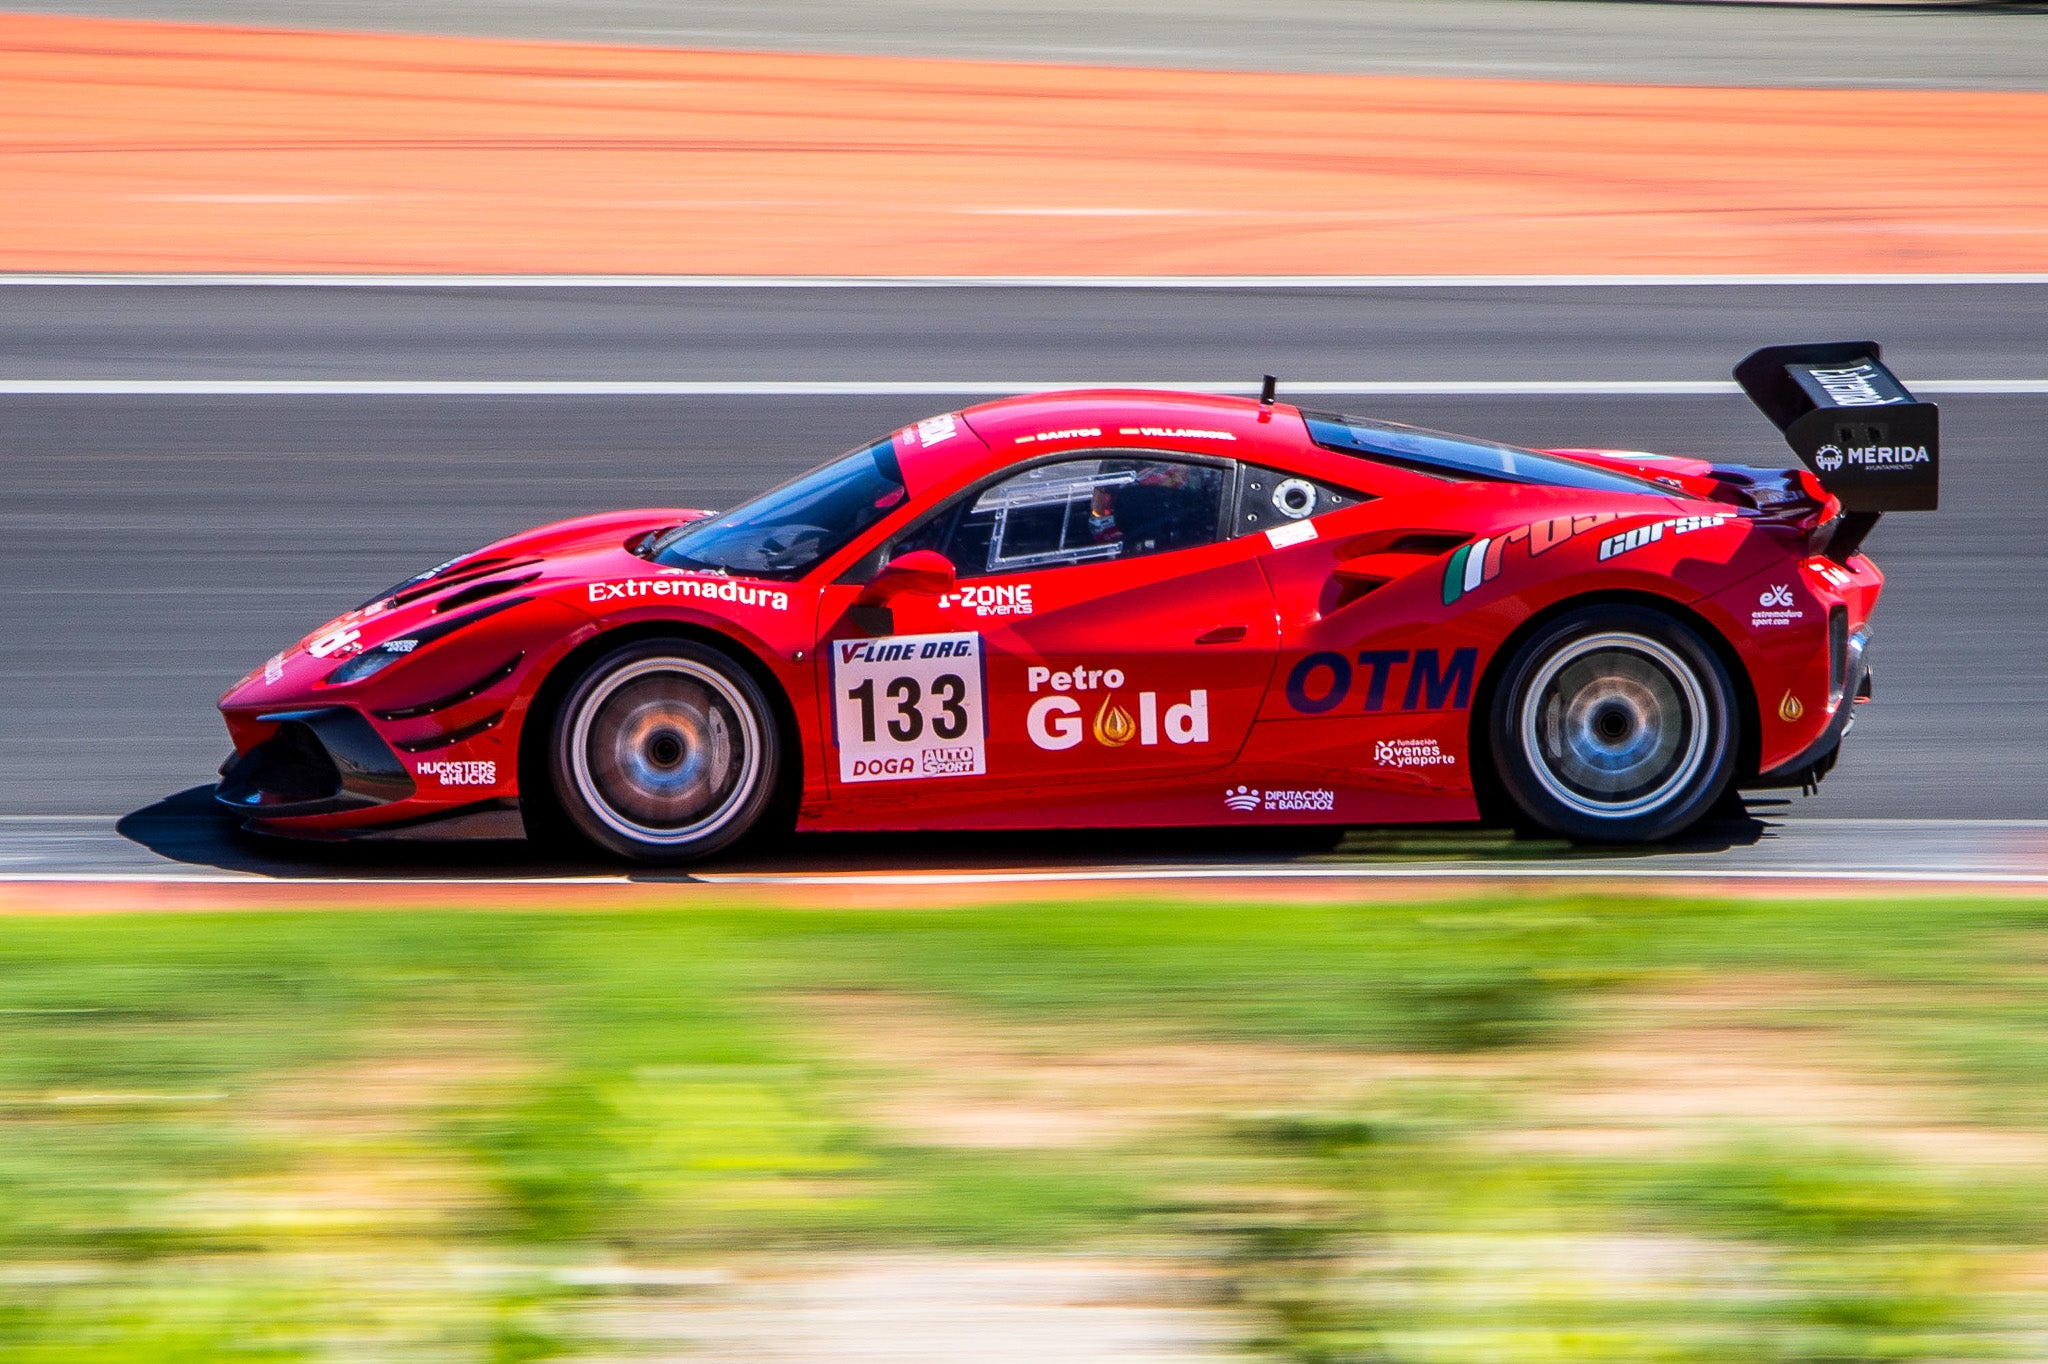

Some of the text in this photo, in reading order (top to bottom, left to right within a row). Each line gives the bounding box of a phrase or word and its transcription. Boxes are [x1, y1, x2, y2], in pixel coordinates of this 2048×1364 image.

[1848, 445, 1930, 464] MÉRIDA
[588, 579, 789, 611] Extremadura
[976, 604, 1033, 616] events
[841, 640, 973, 664] V-LINE ORG.
[1027, 665, 1125, 692] Petro
[1285, 647, 1479, 715] OTM
[848, 673, 968, 743] 133
[923, 747, 974, 763] AUTO
[1396, 754, 1456, 768] ydeporte
[417, 761, 497, 775] HUCKSTERS
[853, 757, 915, 776] DOGA
[923, 761, 974, 775] SPORT
[440, 773, 497, 785] &HUCKS
[1264, 788, 1334, 801] DIPUTACIÓN
[1278, 800, 1334, 811] BADAJOZ
